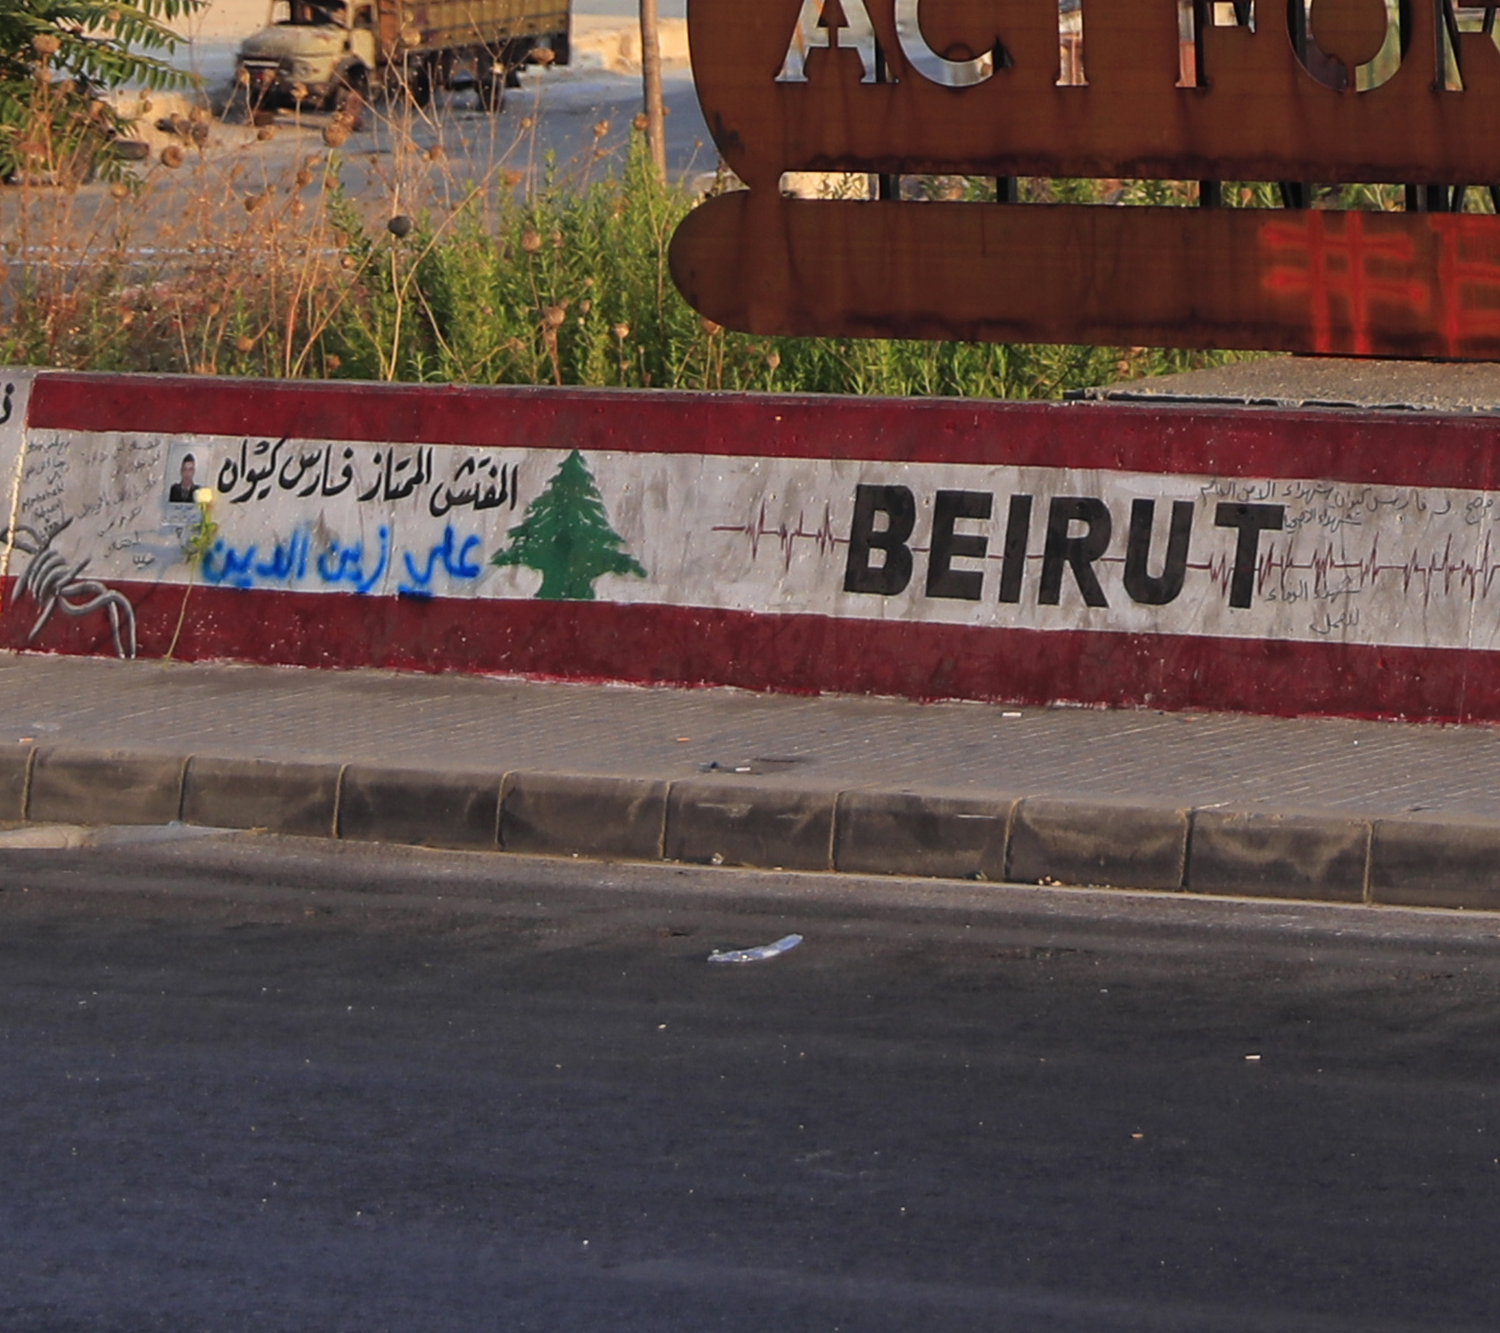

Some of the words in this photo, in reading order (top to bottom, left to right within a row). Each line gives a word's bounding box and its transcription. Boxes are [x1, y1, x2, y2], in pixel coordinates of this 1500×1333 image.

[278, 443, 353, 499] فارس
[357, 445, 434, 503] الممتاز
[429, 454, 520, 518] المفتش
[200, 520, 313, 590] الدين
[316, 522, 391, 595] زين
[396, 522, 483, 599] علي
[843, 483, 1285, 611] BEIRUT
